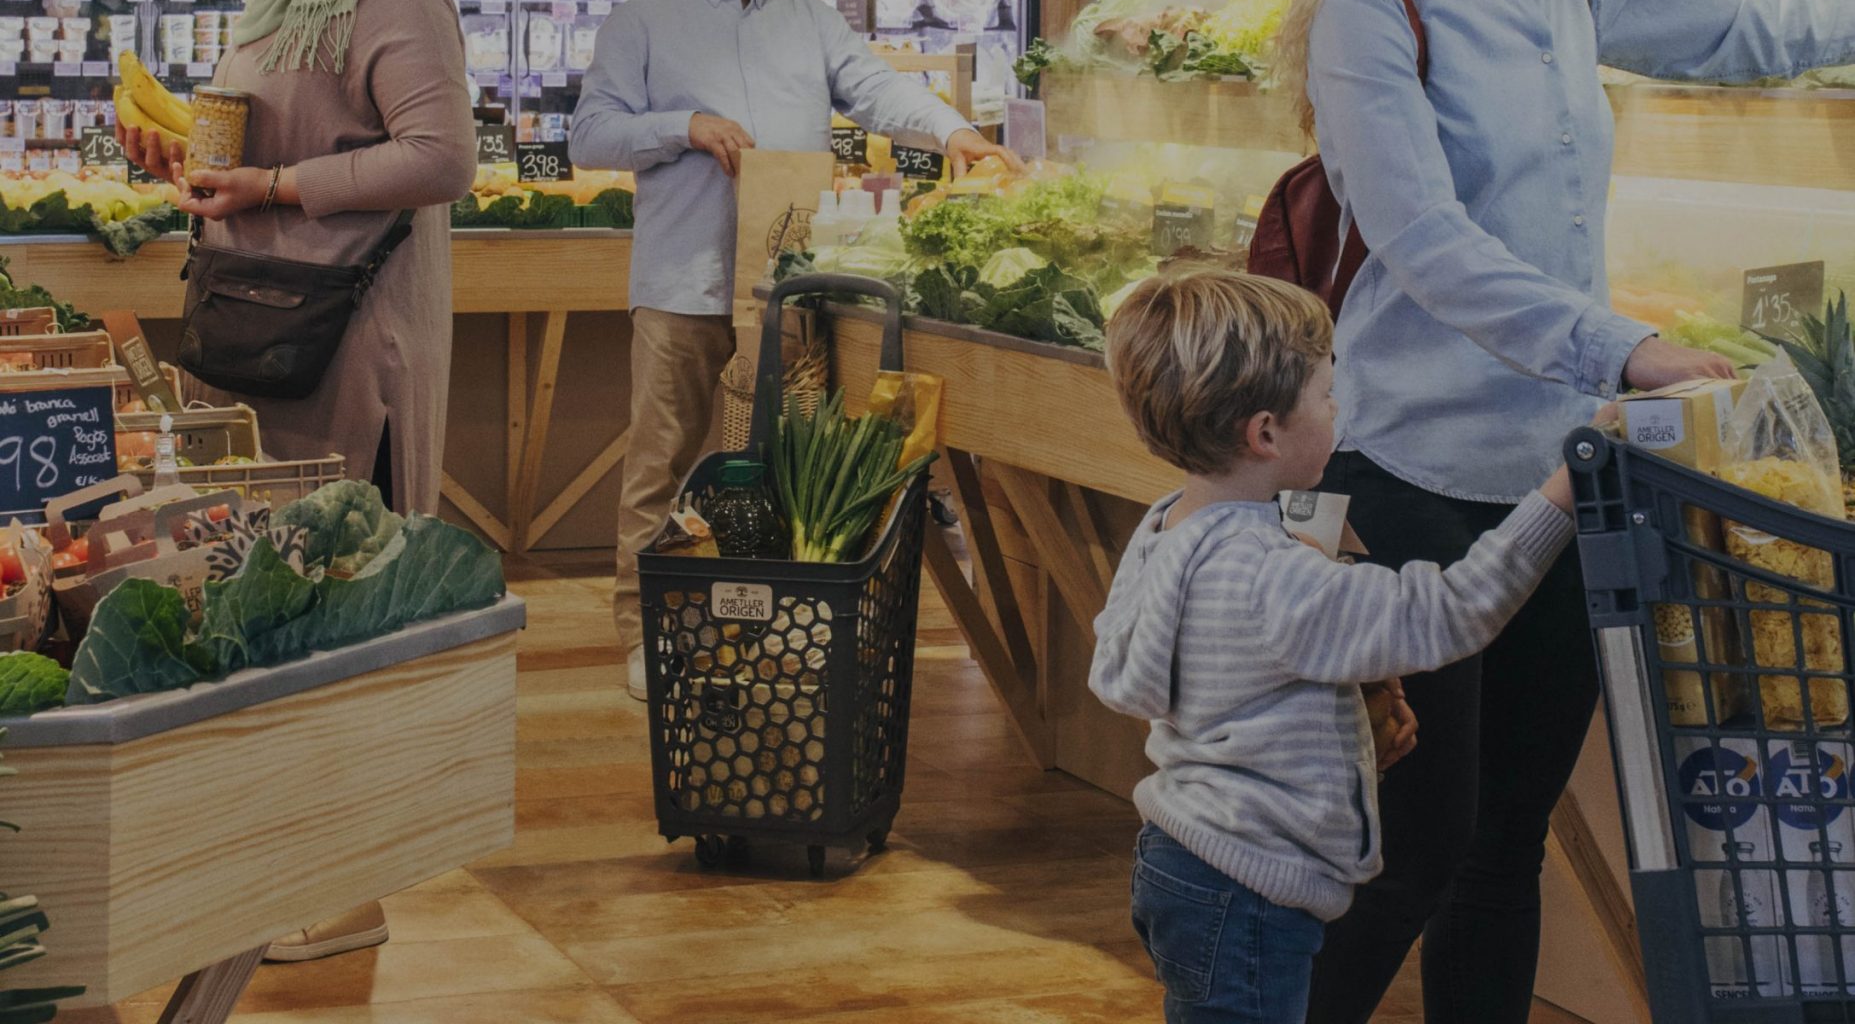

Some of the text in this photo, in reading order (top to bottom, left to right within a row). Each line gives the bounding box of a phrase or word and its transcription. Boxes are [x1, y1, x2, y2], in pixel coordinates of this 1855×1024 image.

[896, 150, 932, 169] 3'75
[1752, 291, 1791, 329] 1'35
[24, 399, 76, 413] branca
[46, 407, 100, 428] granell
[1636, 425, 1676, 434] AMETLLER
[1636, 432, 1676, 443] ORIGEN
[75, 476, 106, 487] €/K
[720, 597, 765, 608] AMETLLER
[719, 605, 765, 618] ORIGEN
[1703, 804, 1737, 814] Nata
